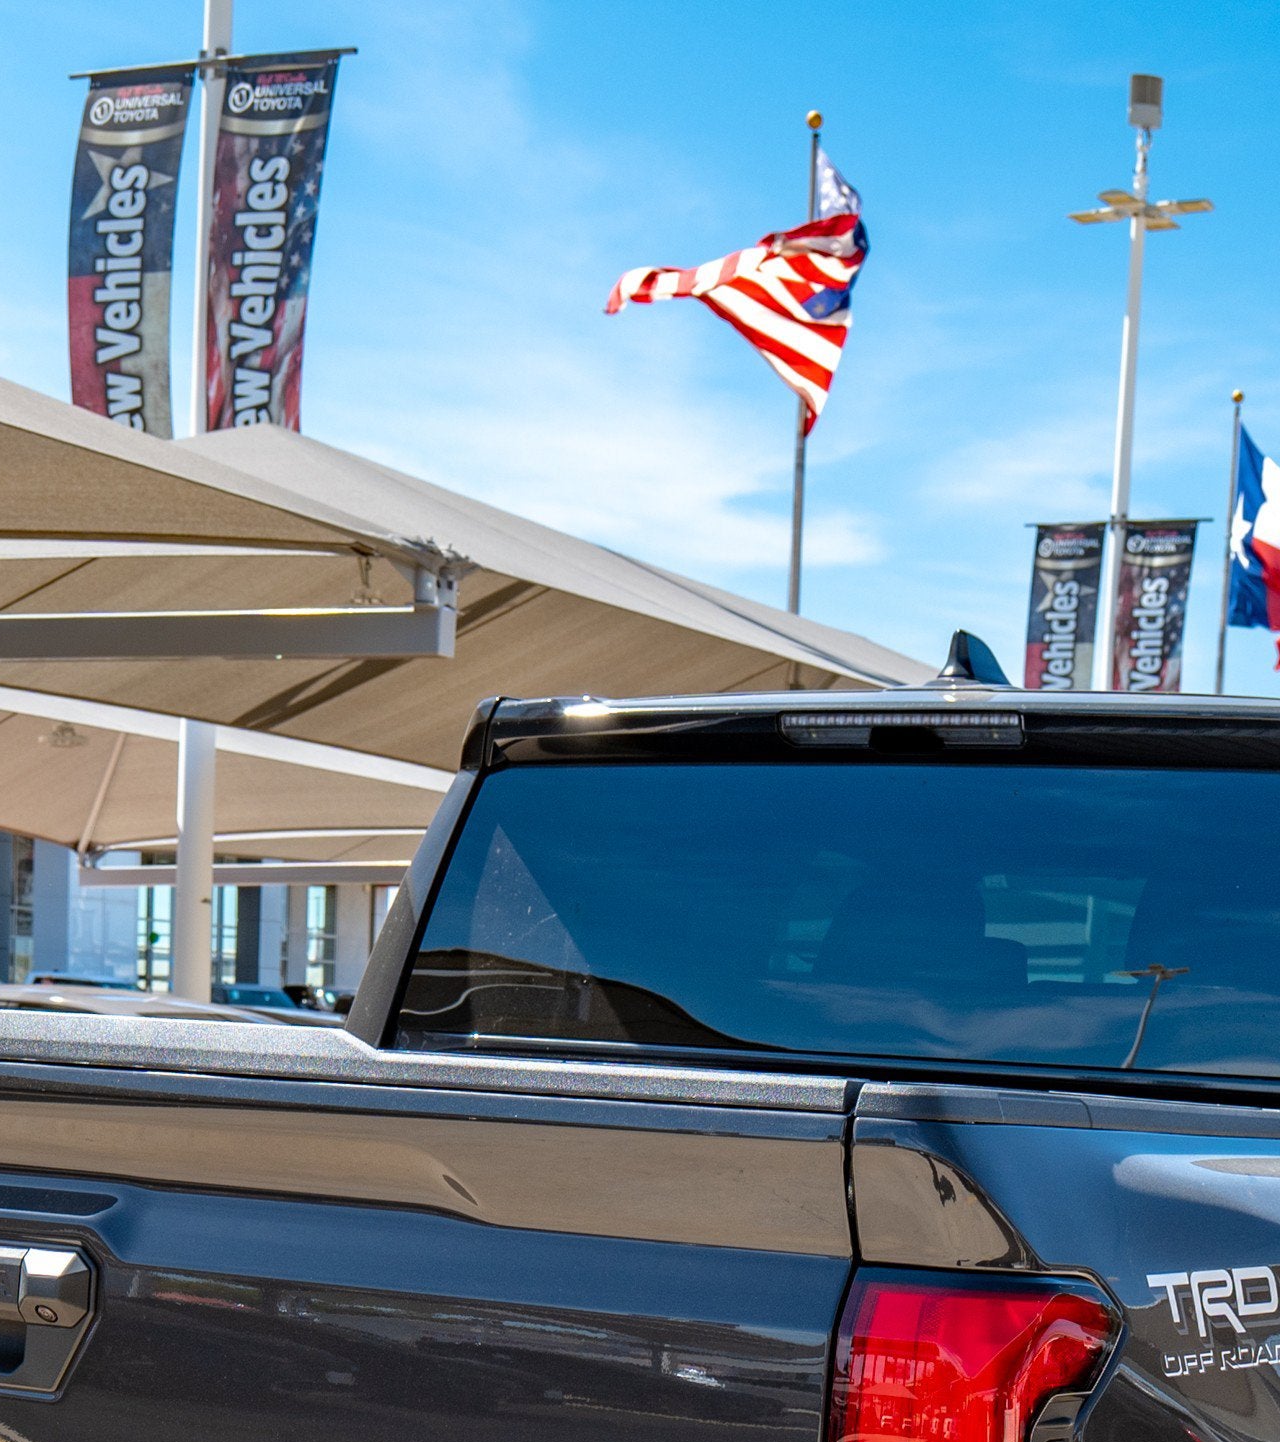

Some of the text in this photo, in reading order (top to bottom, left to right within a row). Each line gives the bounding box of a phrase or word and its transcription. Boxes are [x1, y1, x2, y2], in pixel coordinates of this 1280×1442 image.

[114, 92, 184, 110] UNIVERSAL
[254, 79, 328, 98] UNIVERSAL
[113, 108, 159, 123] TOYOTA
[253, 96, 302, 112] TOYOTA
[95, 163, 149, 432] ew Vehicles
[230, 156, 291, 428] ew Vehicles
[1041, 580, 1080, 690] Vehicles
[1130, 577, 1170, 691] Vehicles
[1163, 1350, 1214, 1378] OFF
